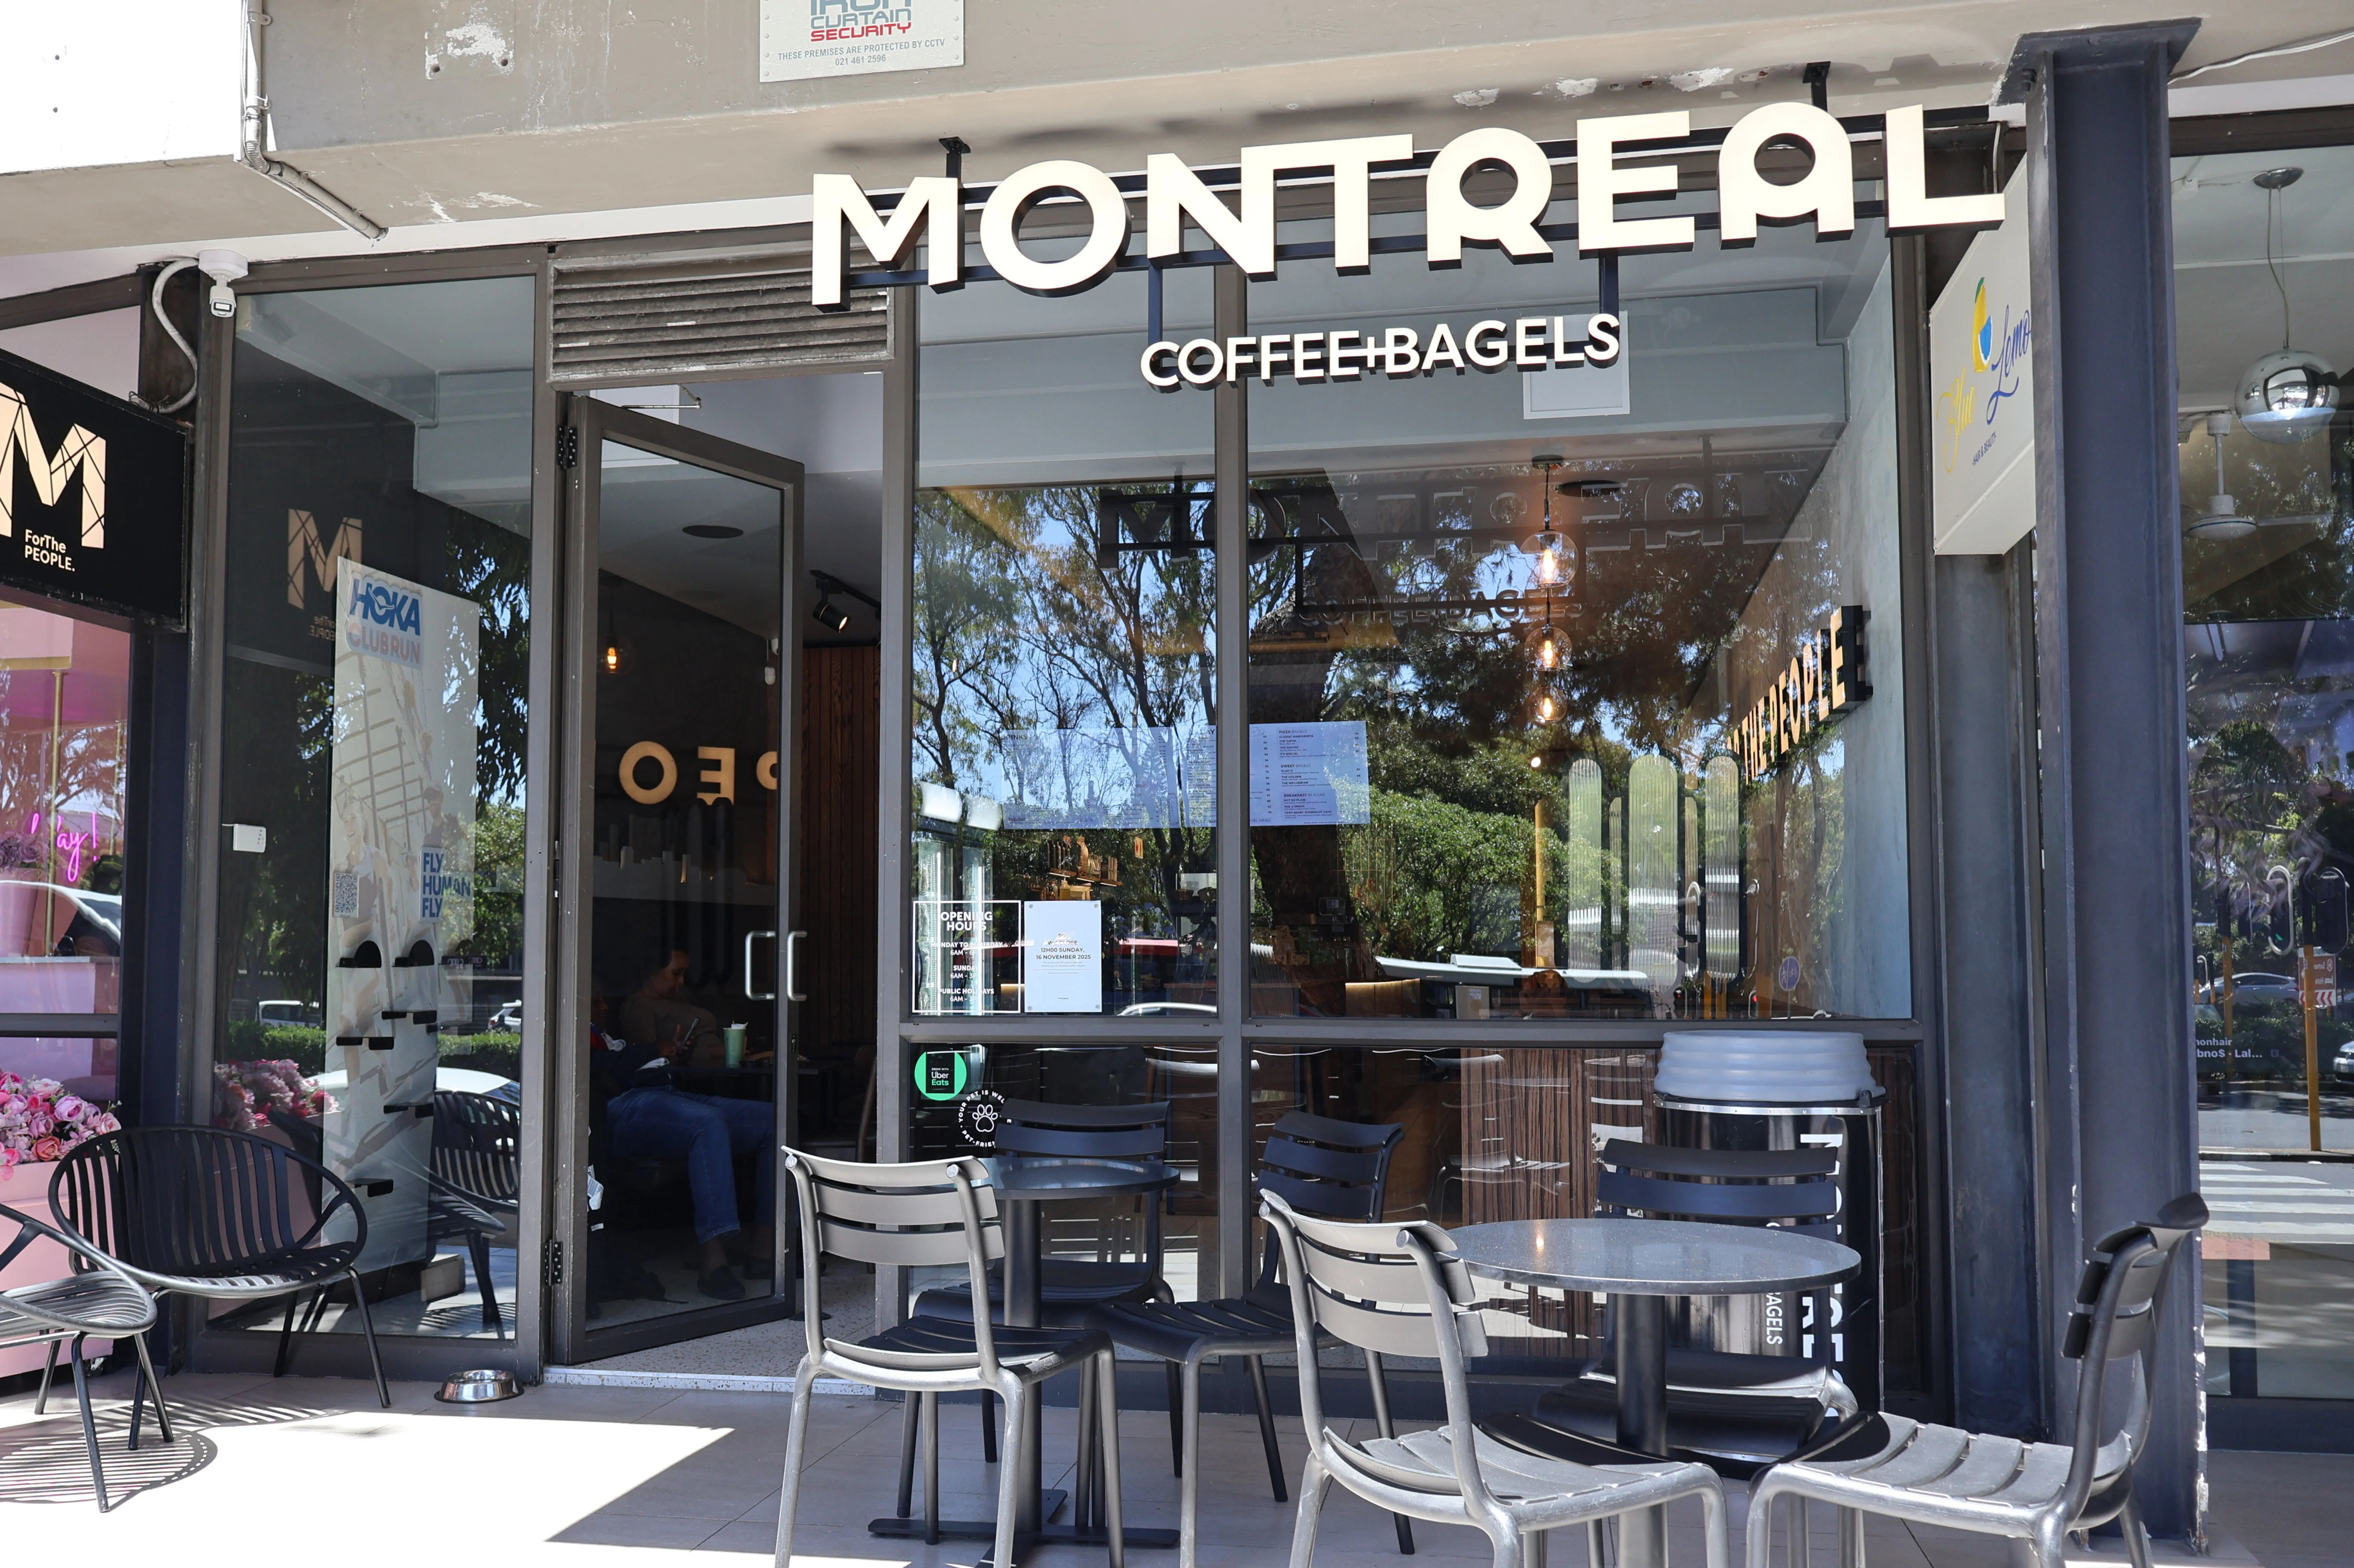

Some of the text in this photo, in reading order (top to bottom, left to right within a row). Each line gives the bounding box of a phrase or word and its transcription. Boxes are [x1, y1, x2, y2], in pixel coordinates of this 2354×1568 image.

[811, 8, 911, 29] CURTAIN
[810, 22, 911, 42] SECURITY
[778, 38, 945, 61] THESE PREMISES ARE PROTECTED BY CCTV
[835, 54, 886, 66] 021 461 2596
[811, 101, 2006, 308] MONTREAL
[1140, 313, 1621, 388] COFFEE+BAGELS
[1986, 304, 2032, 425] Lemo
[350, 578, 421, 636] HOKA
[422, 852, 444, 873] FLY
[422, 875, 471, 897] HUMAN
[422, 898, 443, 918] FLY
[940, 911, 993, 921] OPENING
[947, 921, 987, 931] HOURS
[959, 1102, 967, 1123] YOUR
[966, 1091, 979, 1101] PET
[992, 1091, 1005, 1104] WEL
